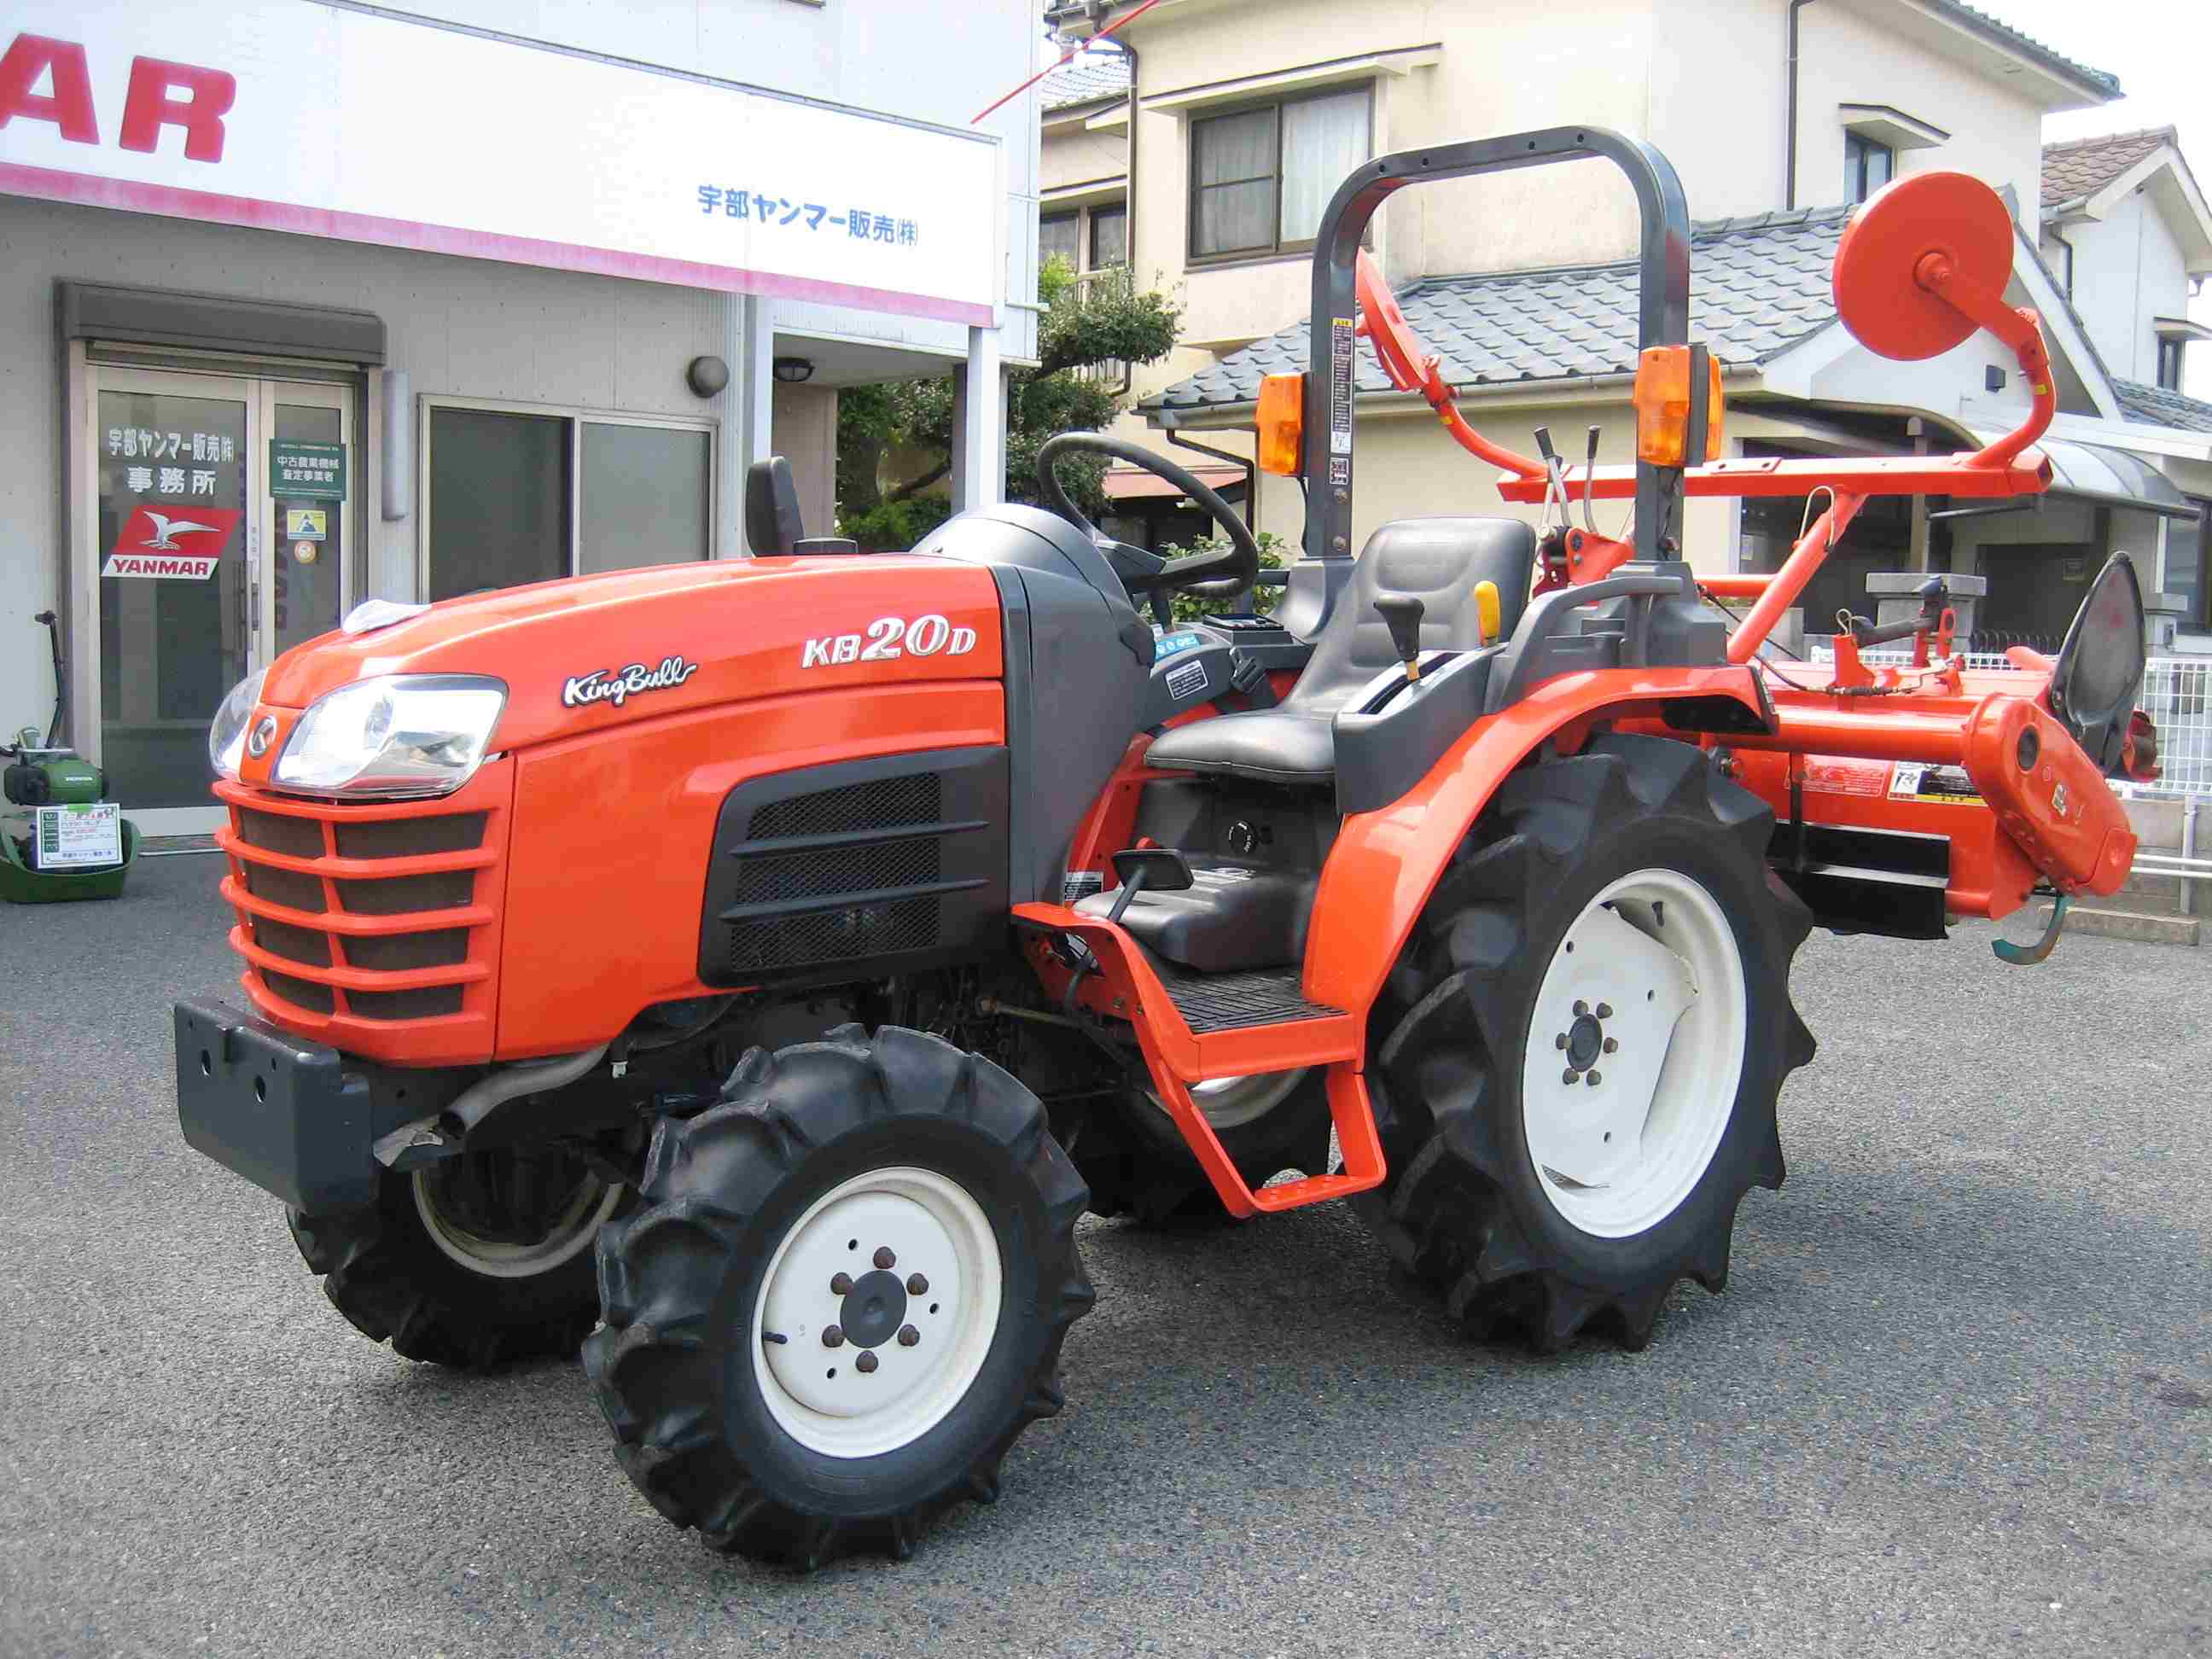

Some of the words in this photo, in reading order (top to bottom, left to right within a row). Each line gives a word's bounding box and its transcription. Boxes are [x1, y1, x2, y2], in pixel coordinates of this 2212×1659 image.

[0, 32, 236, 164] AR
[127, 467, 216, 495] 事務所
[113, 558, 210, 575] YANMAR
